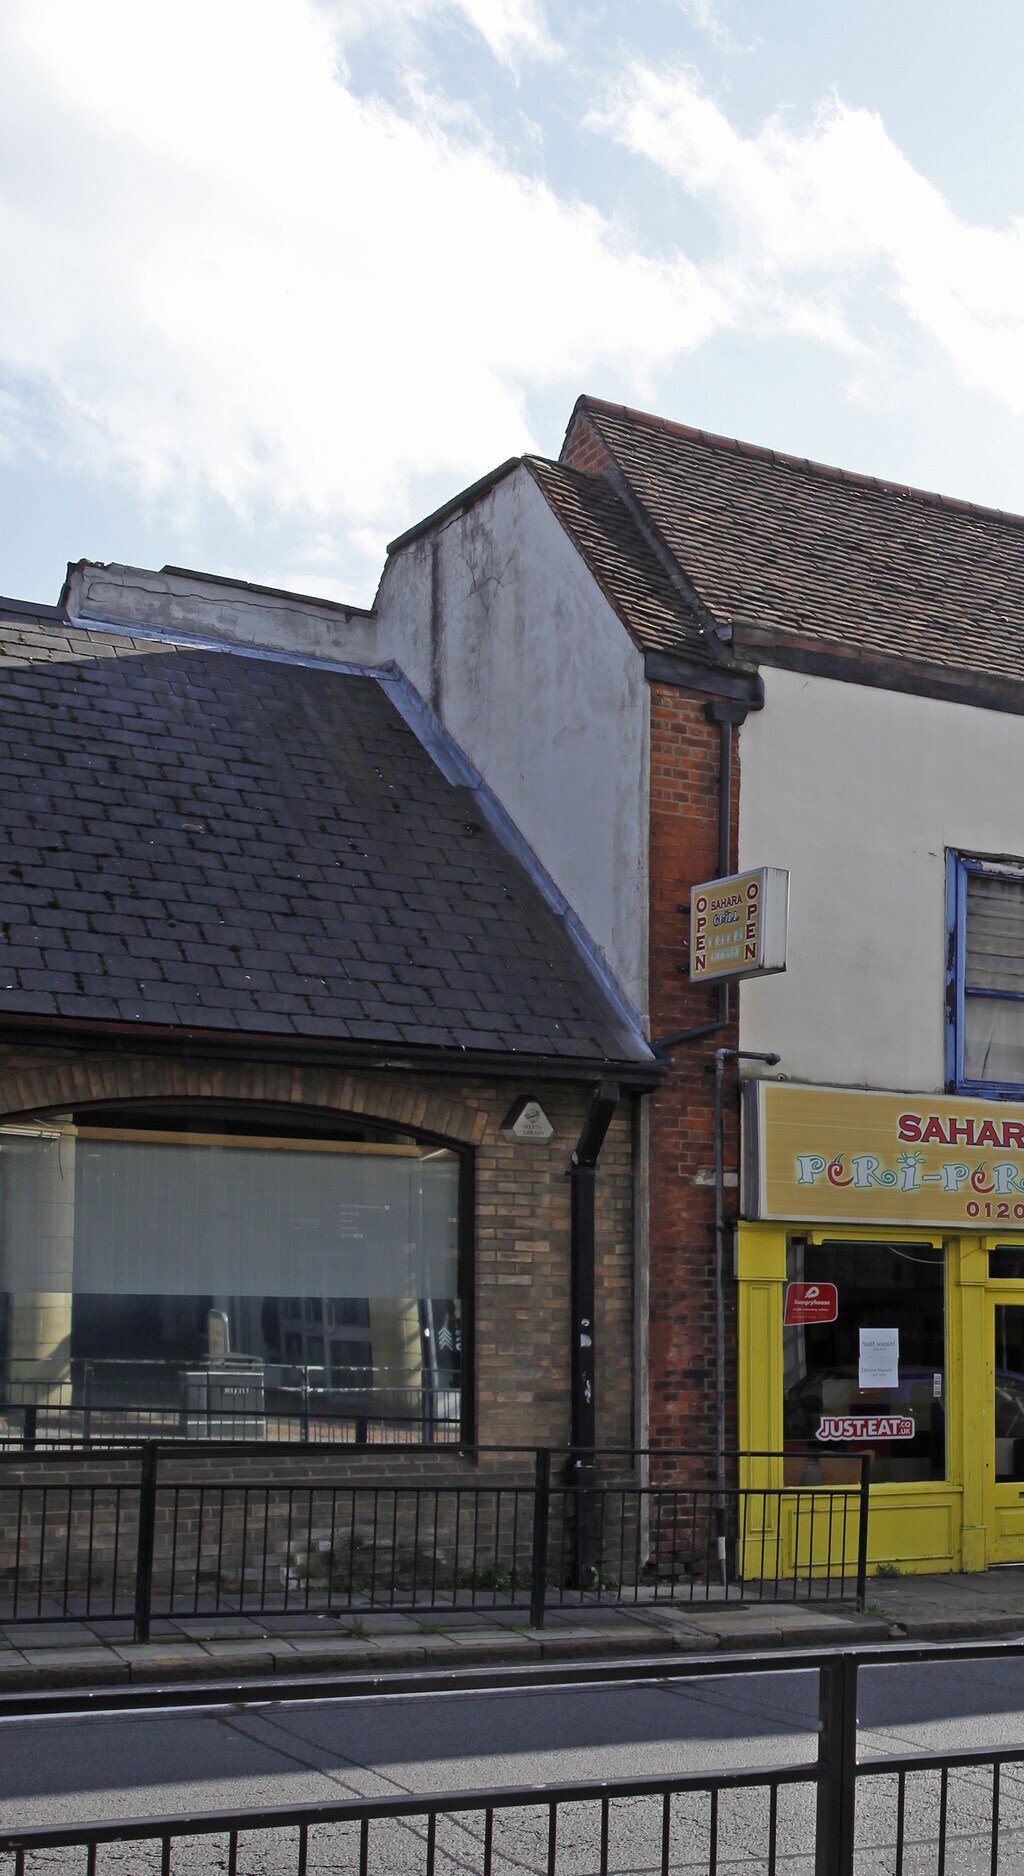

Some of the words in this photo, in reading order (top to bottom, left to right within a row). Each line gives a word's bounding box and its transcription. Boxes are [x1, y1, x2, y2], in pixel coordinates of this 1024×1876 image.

[711, 894, 743, 911] SAHARA
[745, 883, 759, 960] OPEN
[695, 897, 707, 971] OPEN
[820, 1420, 864, 1437] JUST
[868, 1419, 900, 1436] EAT
